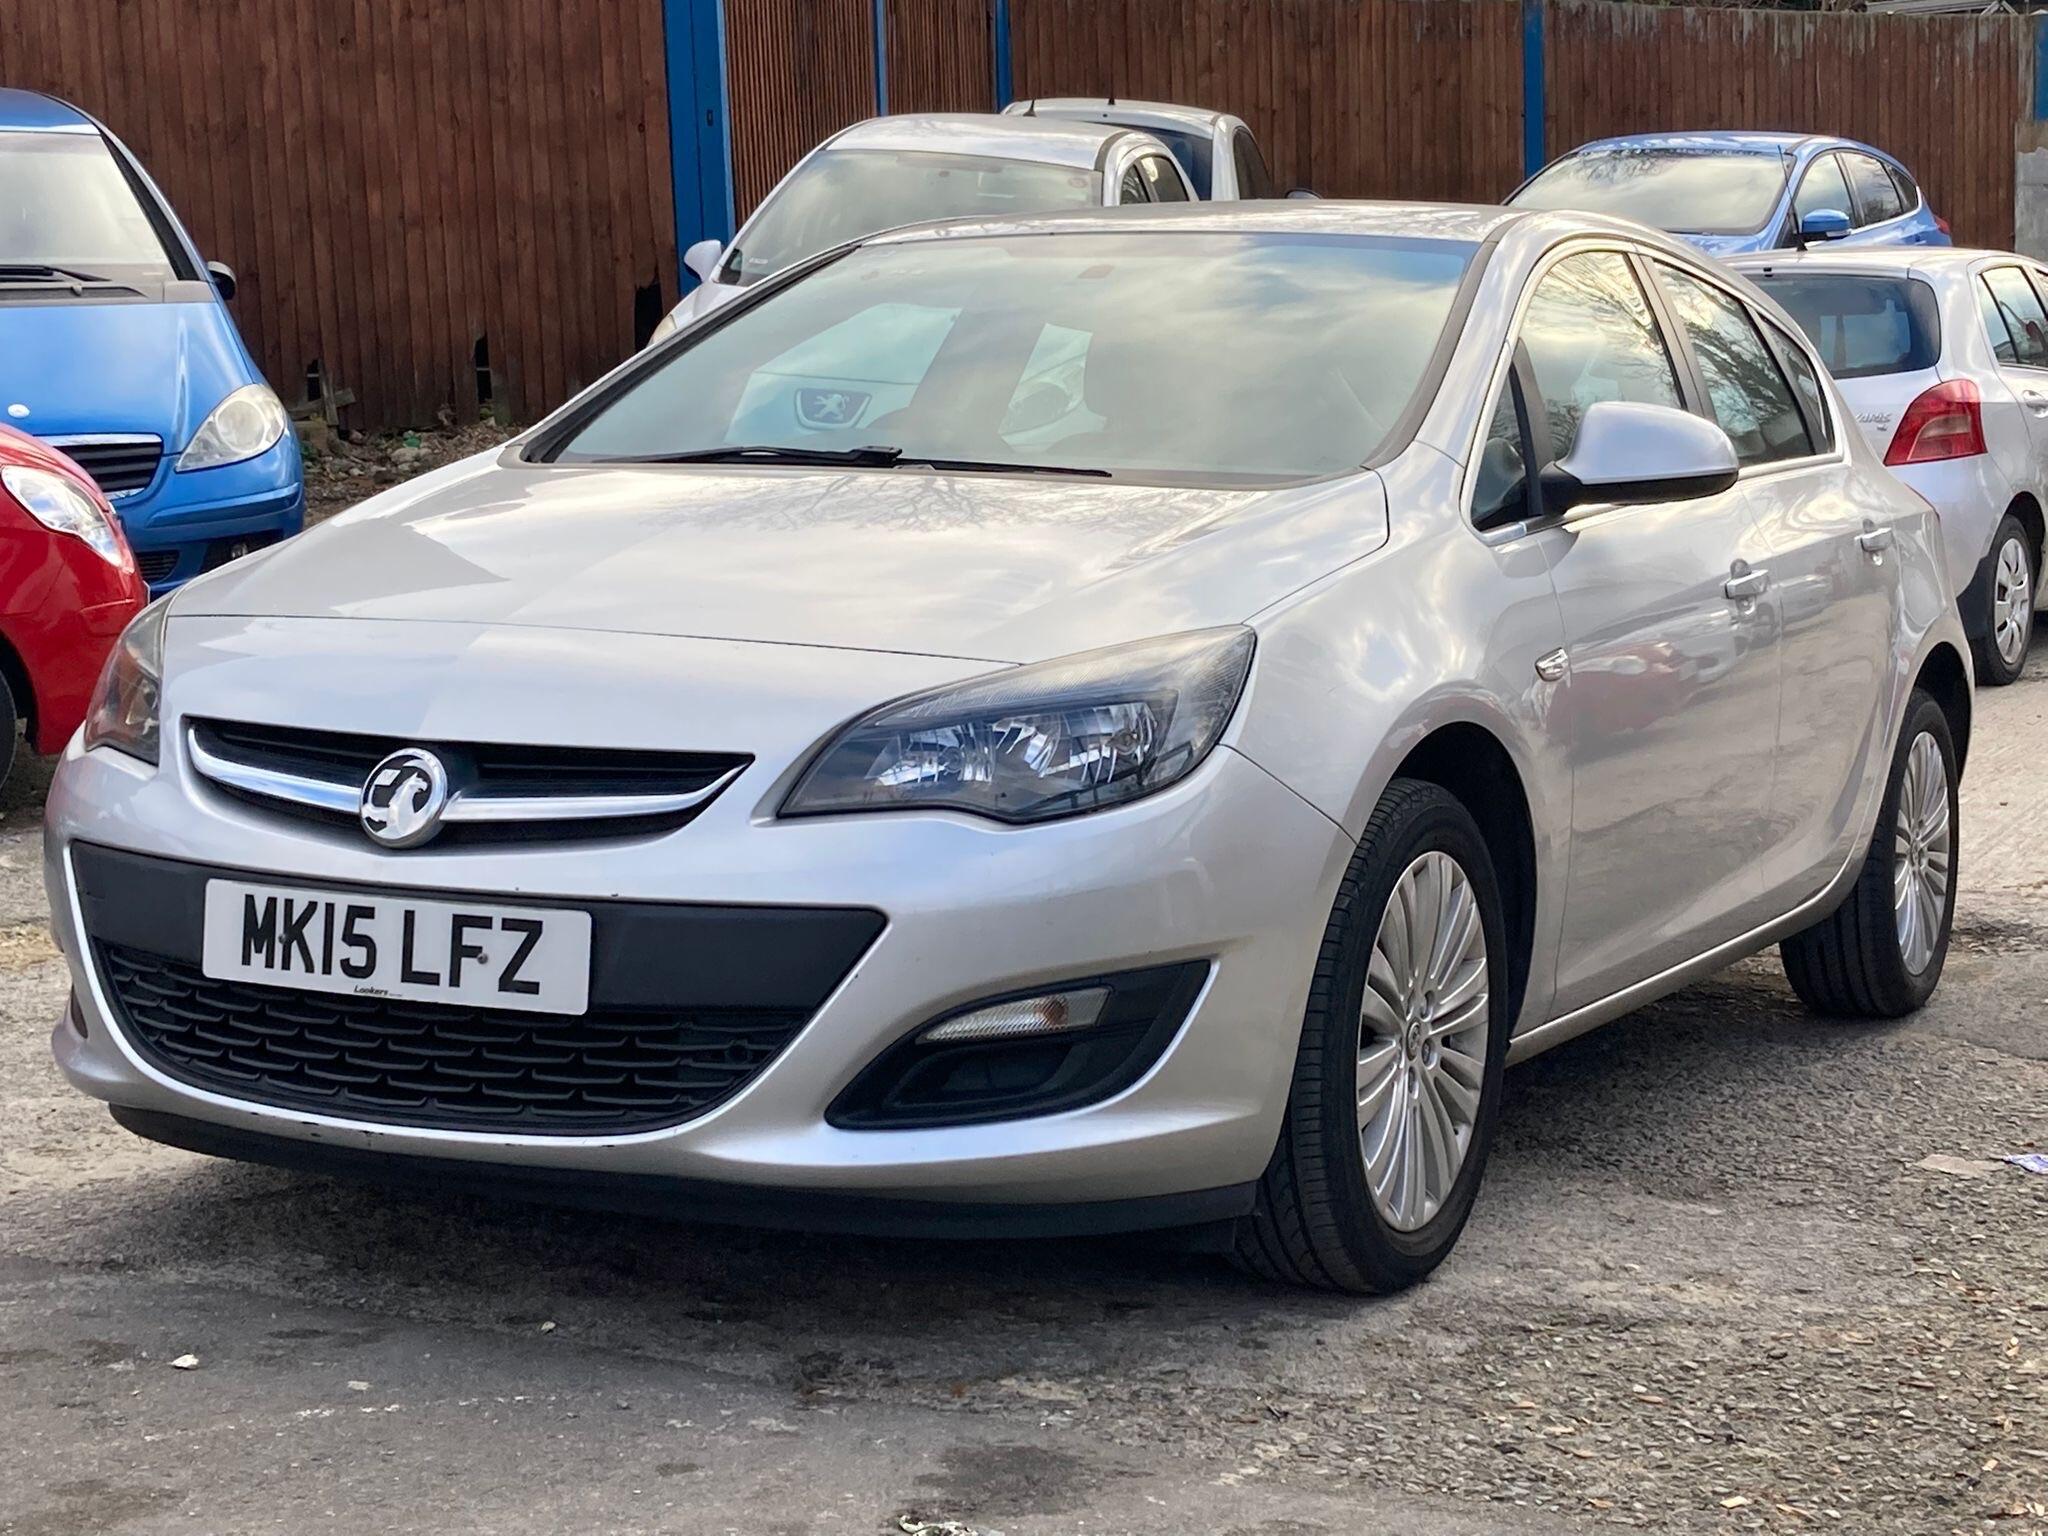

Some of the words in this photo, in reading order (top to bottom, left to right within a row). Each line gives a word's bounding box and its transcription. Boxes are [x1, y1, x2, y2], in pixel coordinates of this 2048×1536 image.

[242, 894, 376, 979] MK15
[401, 910, 543, 995] LFZ
[353, 985, 389, 996] Lookers
